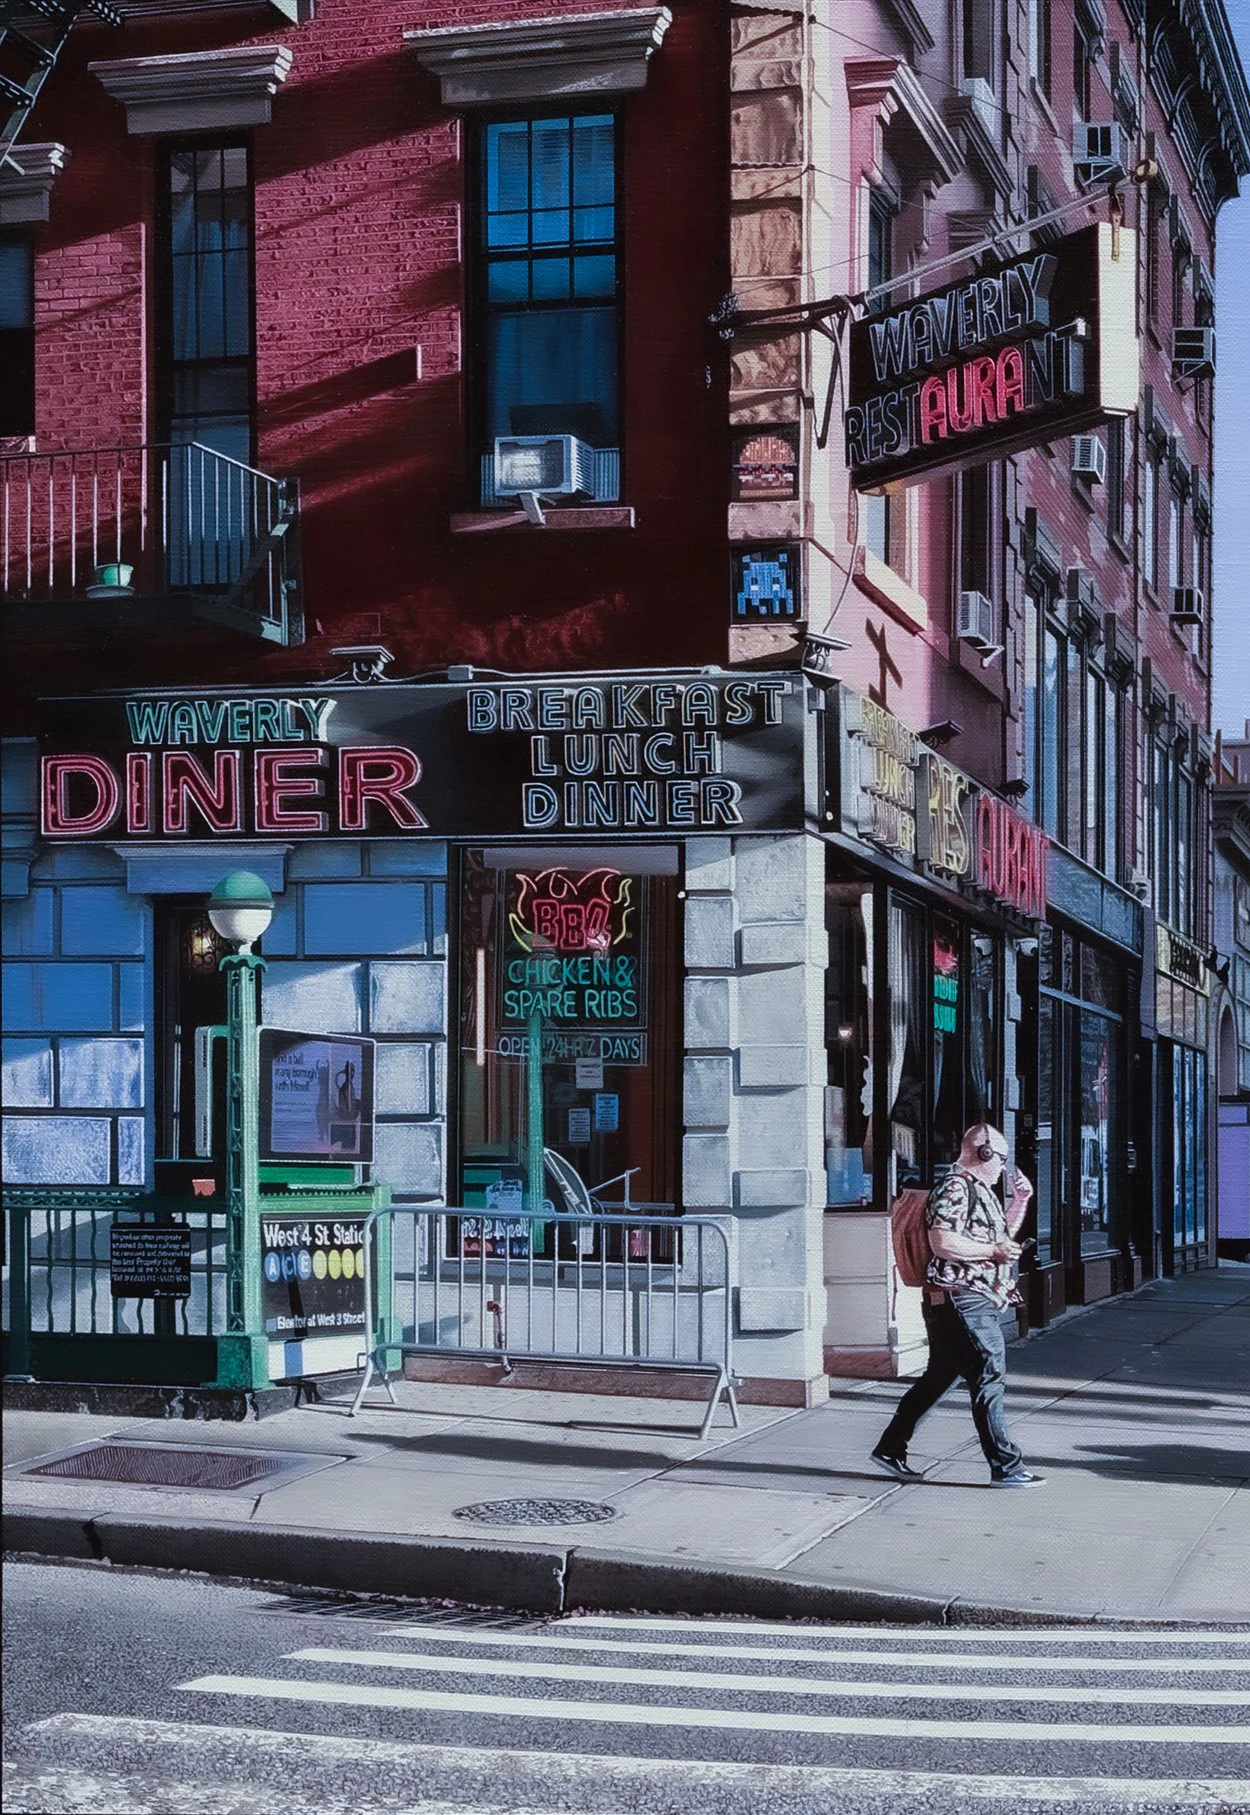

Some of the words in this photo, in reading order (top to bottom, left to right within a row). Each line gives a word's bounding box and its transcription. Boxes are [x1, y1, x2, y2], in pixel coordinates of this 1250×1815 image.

[869, 253, 1056, 381] WAVERLY
[845, 317, 1090, 468] RESTAURANT
[126, 699, 337, 744] WAVERLY
[467, 681, 788, 731] BREAKFAST
[531, 731, 723, 776] LUNCH
[41, 746, 429, 835] DINER
[522, 778, 744, 829] DINNER
[532, 898, 612, 951] BBQ
[508, 957, 610, 986] CHICKEN
[615, 956, 634, 987] &
[504, 990, 577, 1019] SPARE
[585, 989, 638, 1019] RIBS
[499, 1036, 531, 1057] OPE
[600, 1037, 640, 1060] DAYS
[263, 1223, 299, 1247] West
[301, 1223, 312, 1246] 4
[307, 1313, 316, 1327] at
[317, 1312, 335, 1327] West
[336, 1312, 342, 1326] 3
